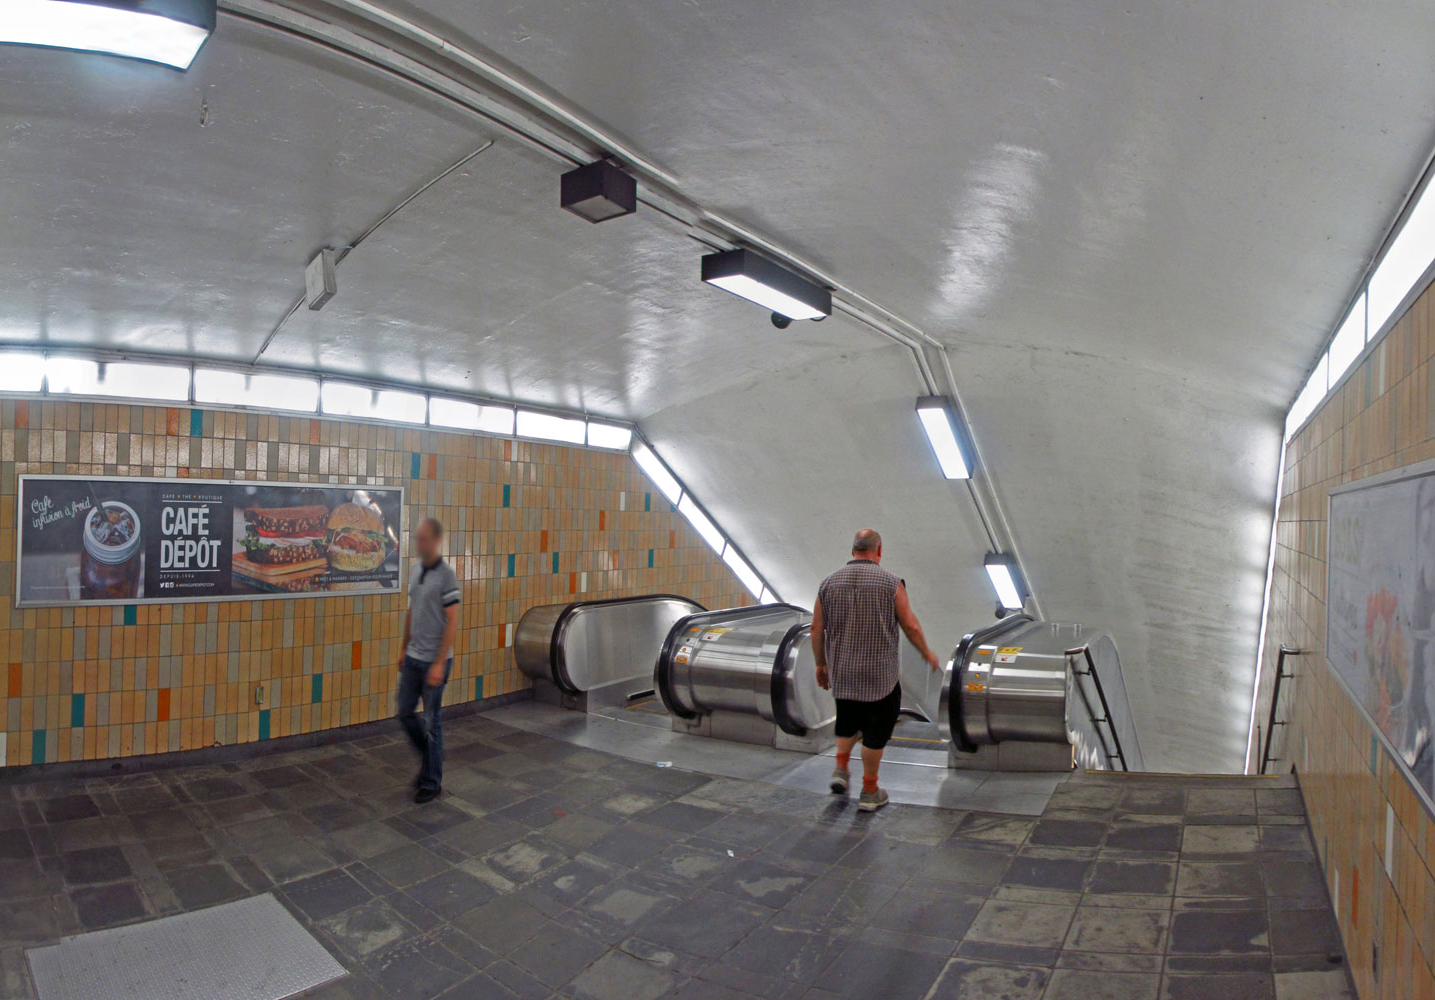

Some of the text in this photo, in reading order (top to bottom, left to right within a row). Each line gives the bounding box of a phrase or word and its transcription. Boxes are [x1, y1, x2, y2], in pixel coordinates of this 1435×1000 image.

[71, 496, 92, 518] froid
[161, 504, 210, 536] CAFÉ
[160, 536, 222, 569] DÉPÔT
